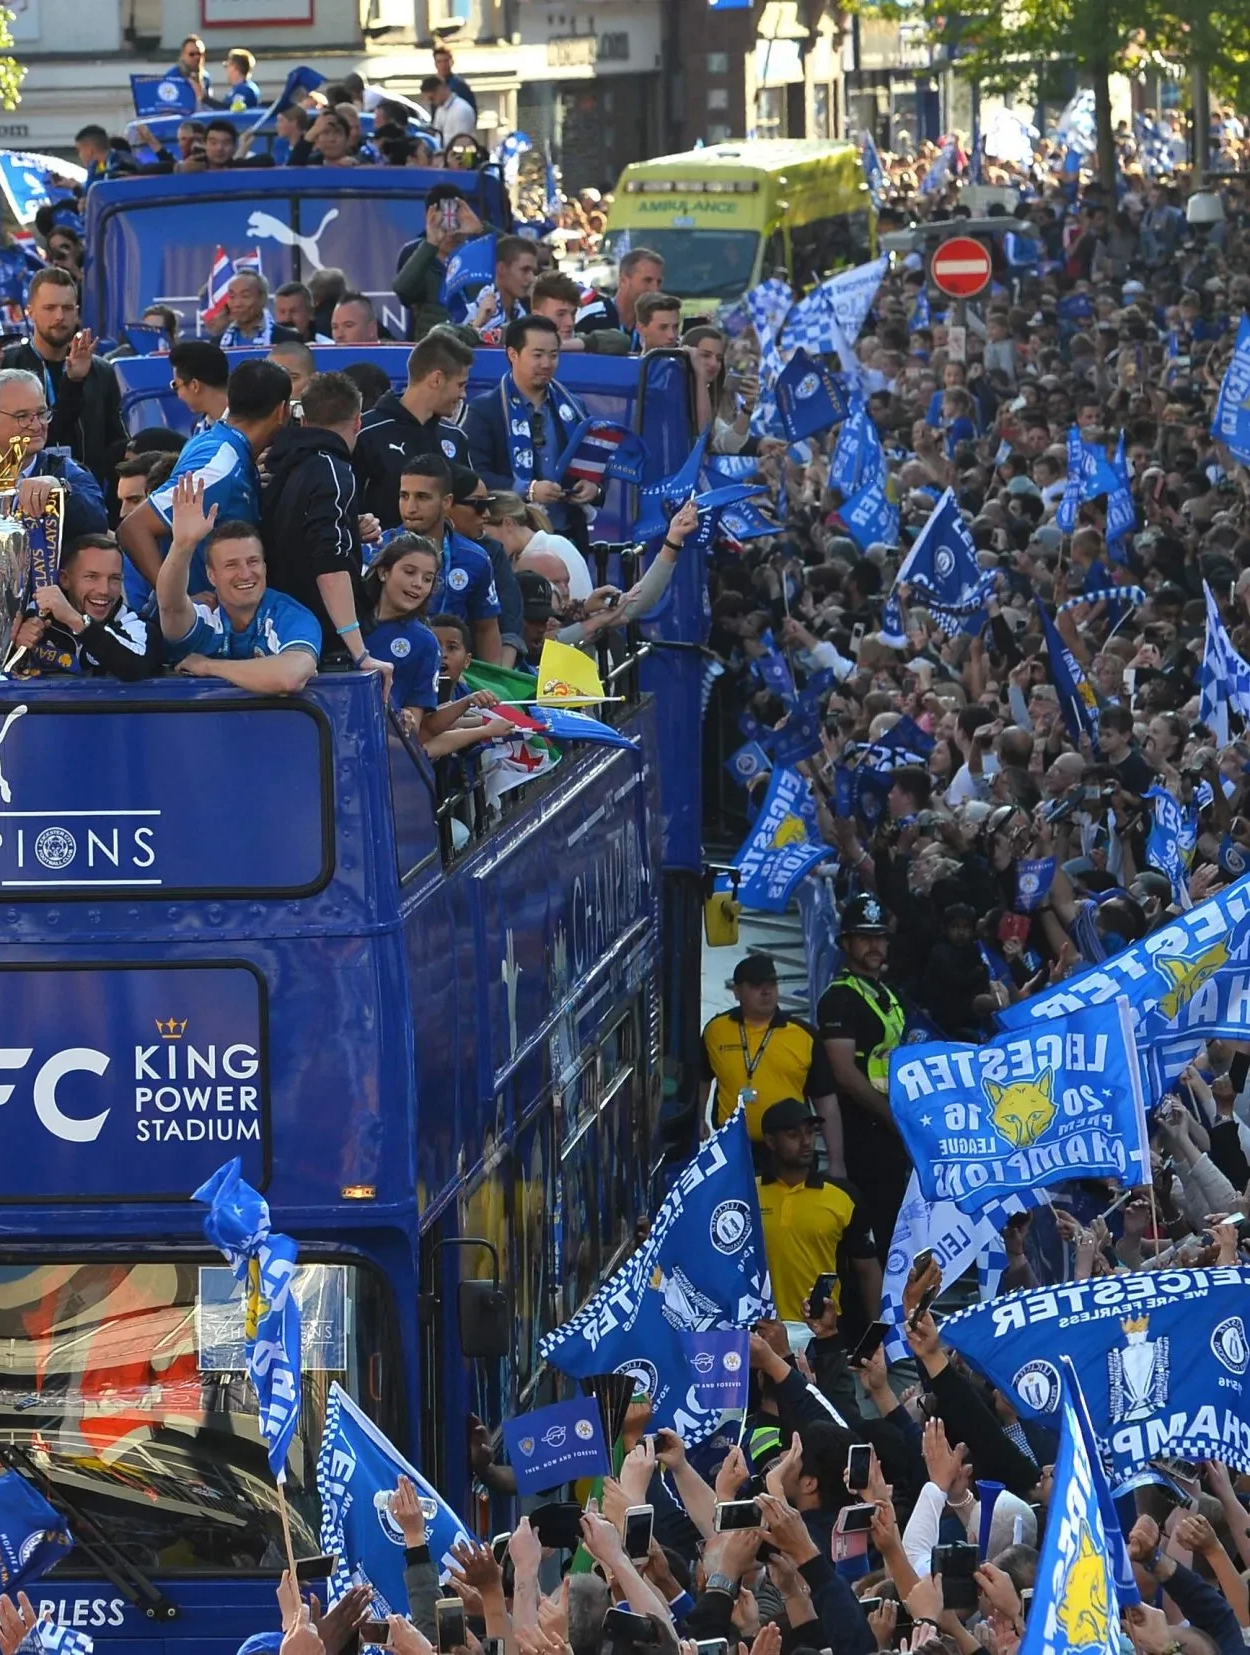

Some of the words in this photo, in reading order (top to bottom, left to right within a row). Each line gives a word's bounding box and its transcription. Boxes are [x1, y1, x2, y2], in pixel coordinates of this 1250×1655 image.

[638, 199, 738, 214] AMBULANCE
[135, 1044, 260, 1081] KING
[135, 1087, 259, 1113] POWER
[135, 1119, 262, 1142] STADIUM
[544, 1459, 558, 1468] NOW
[559, 1454, 572, 1463] AND
[573, 1449, 598, 1459] FOREVER
